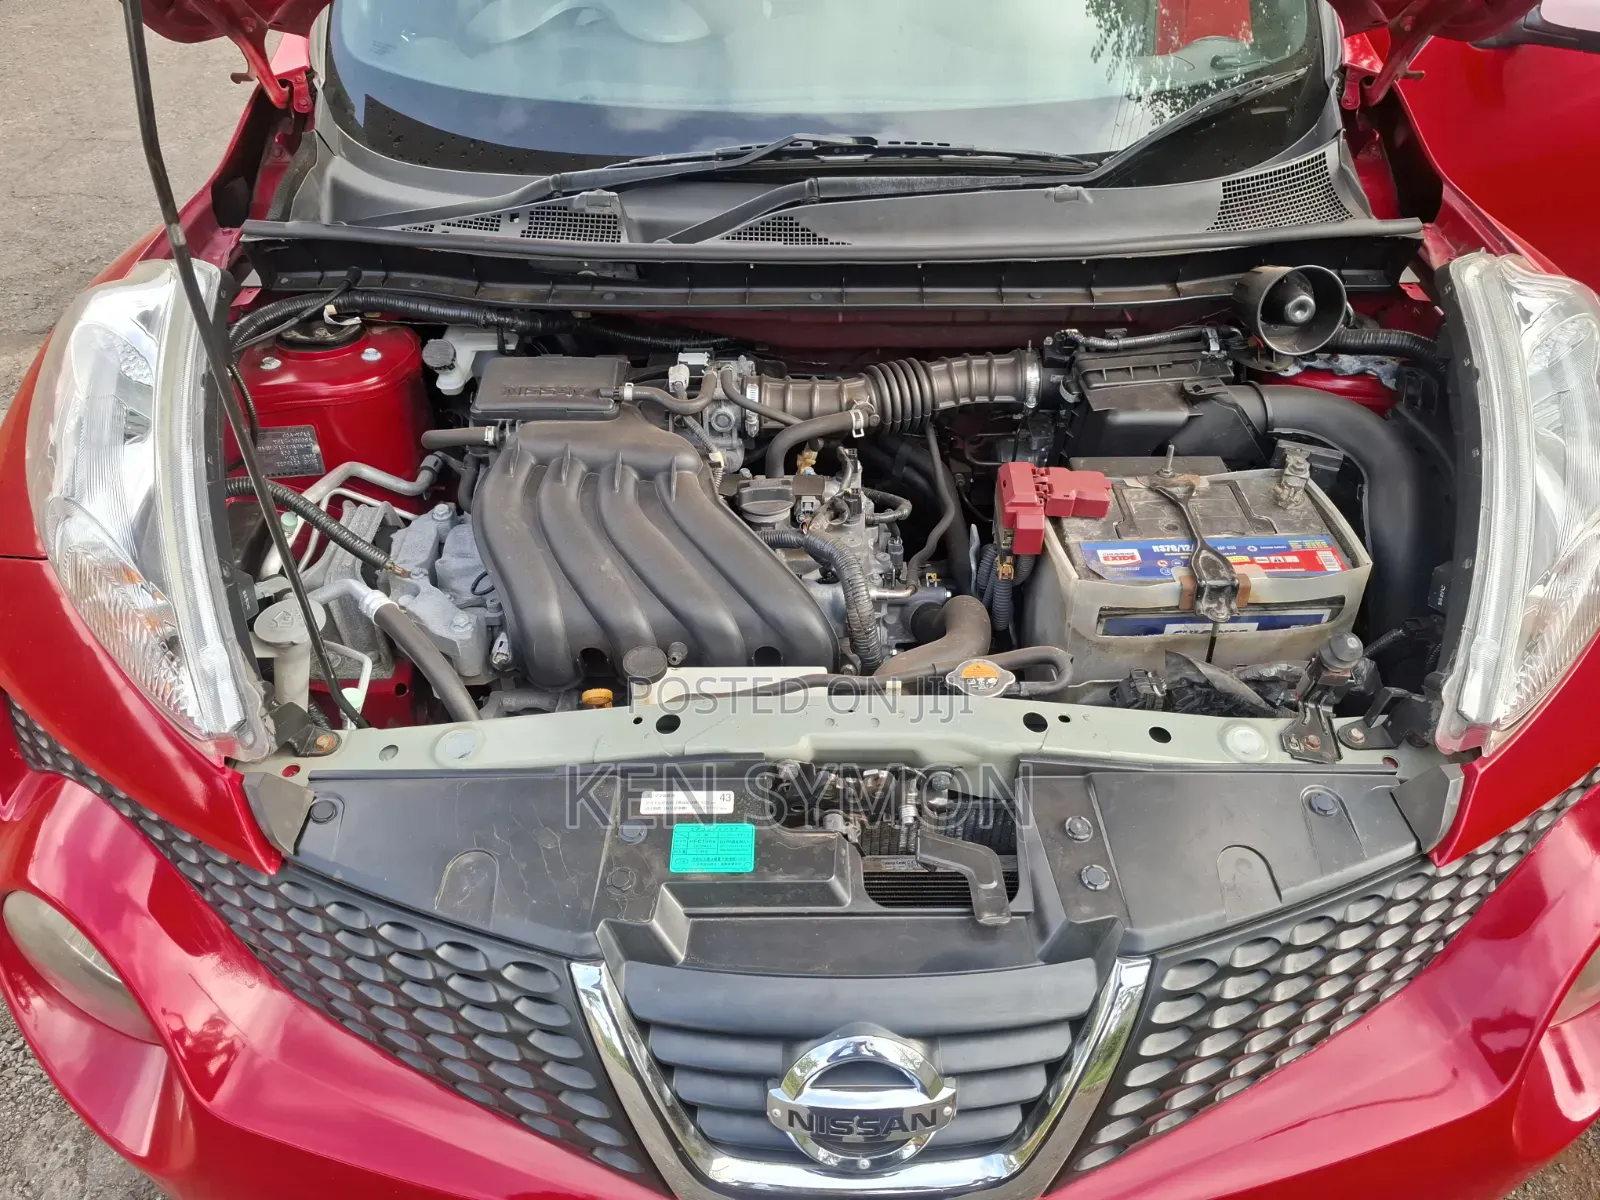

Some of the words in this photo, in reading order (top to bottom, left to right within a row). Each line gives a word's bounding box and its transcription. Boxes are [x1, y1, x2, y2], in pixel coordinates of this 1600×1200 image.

[502, 385, 587, 397] NISSAN
[719, 793, 732, 802] 43
[788, 1109, 937, 1136] NISSAN
